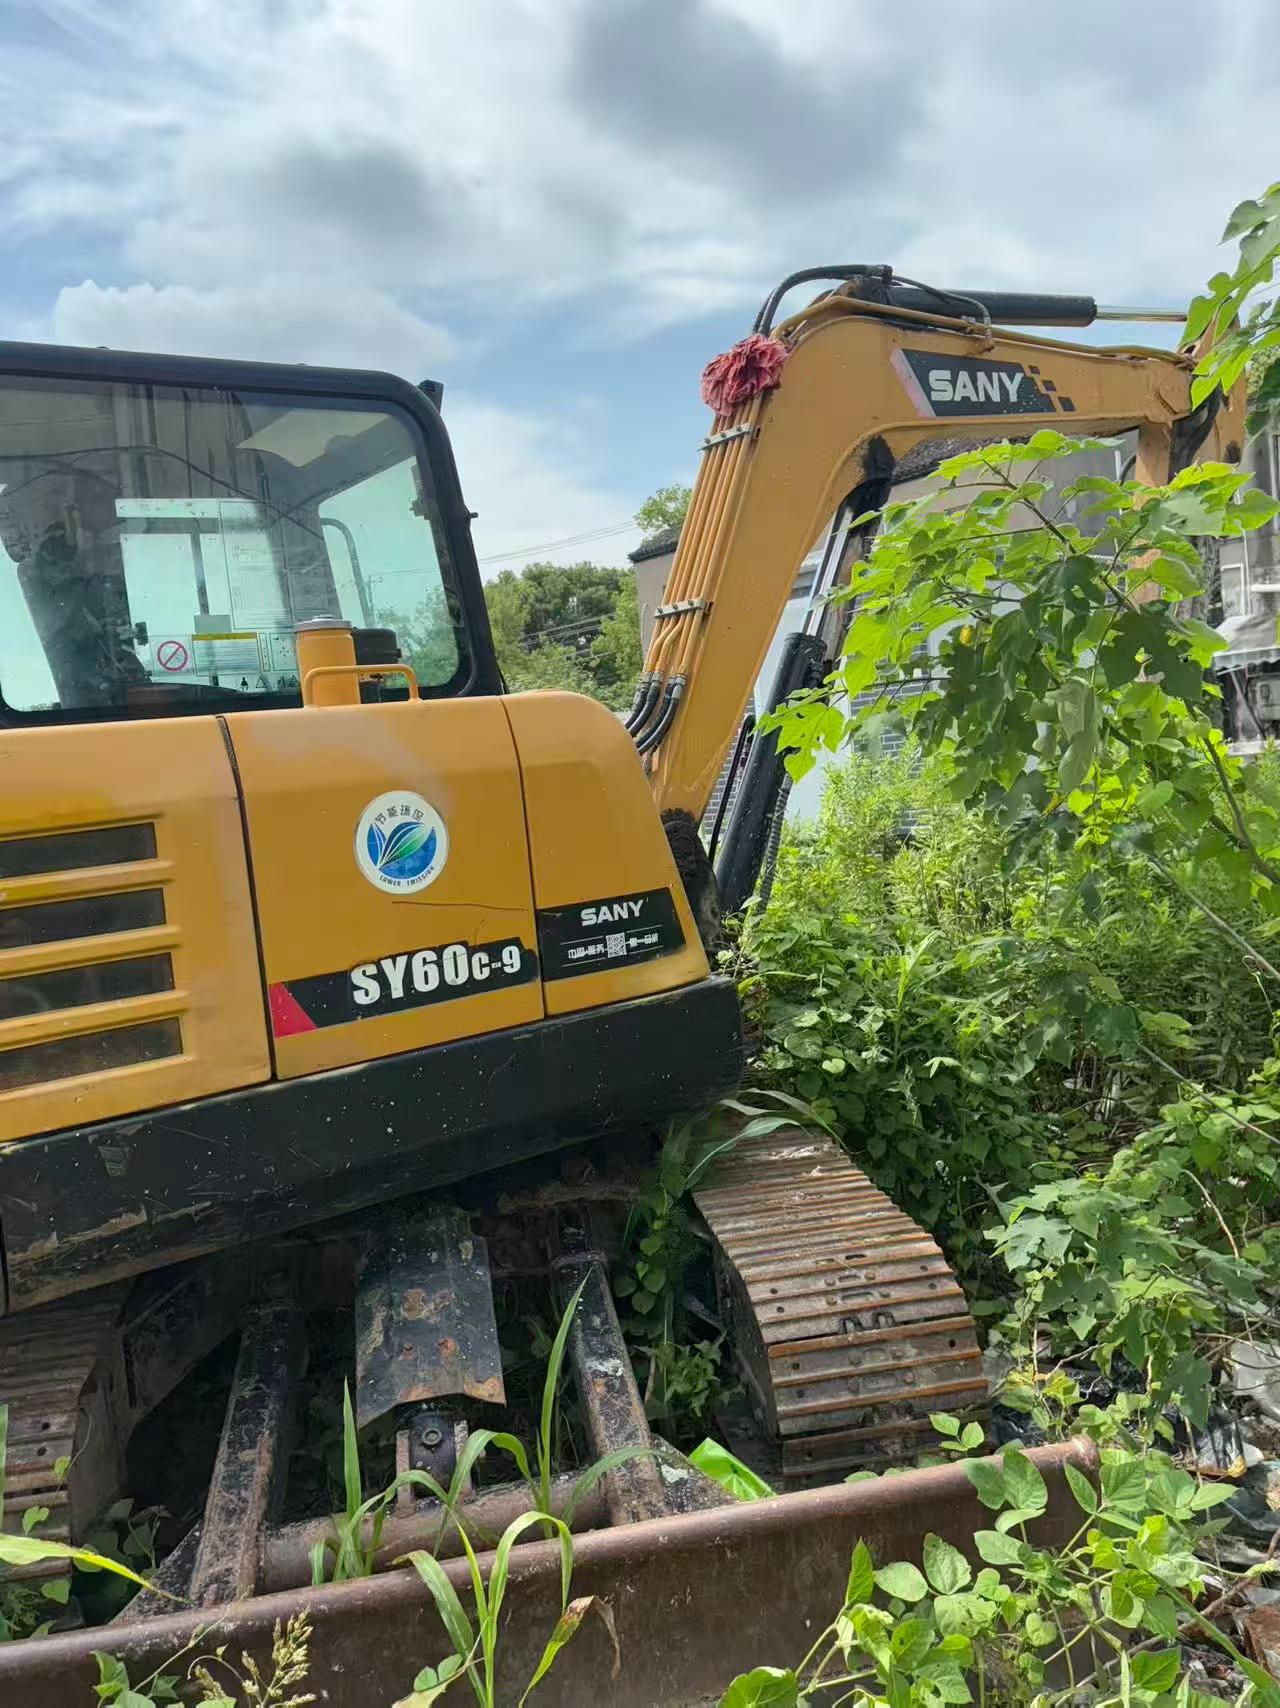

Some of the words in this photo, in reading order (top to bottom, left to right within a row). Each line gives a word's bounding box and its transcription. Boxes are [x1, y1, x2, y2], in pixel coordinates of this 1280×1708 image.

[929, 370, 1024, 402] SANY
[375, 805, 424, 825] 节能环保
[379, 874, 401, 886] LOWER
[406, 865, 435, 886] EMISSION
[581, 899, 645, 927] SANY
